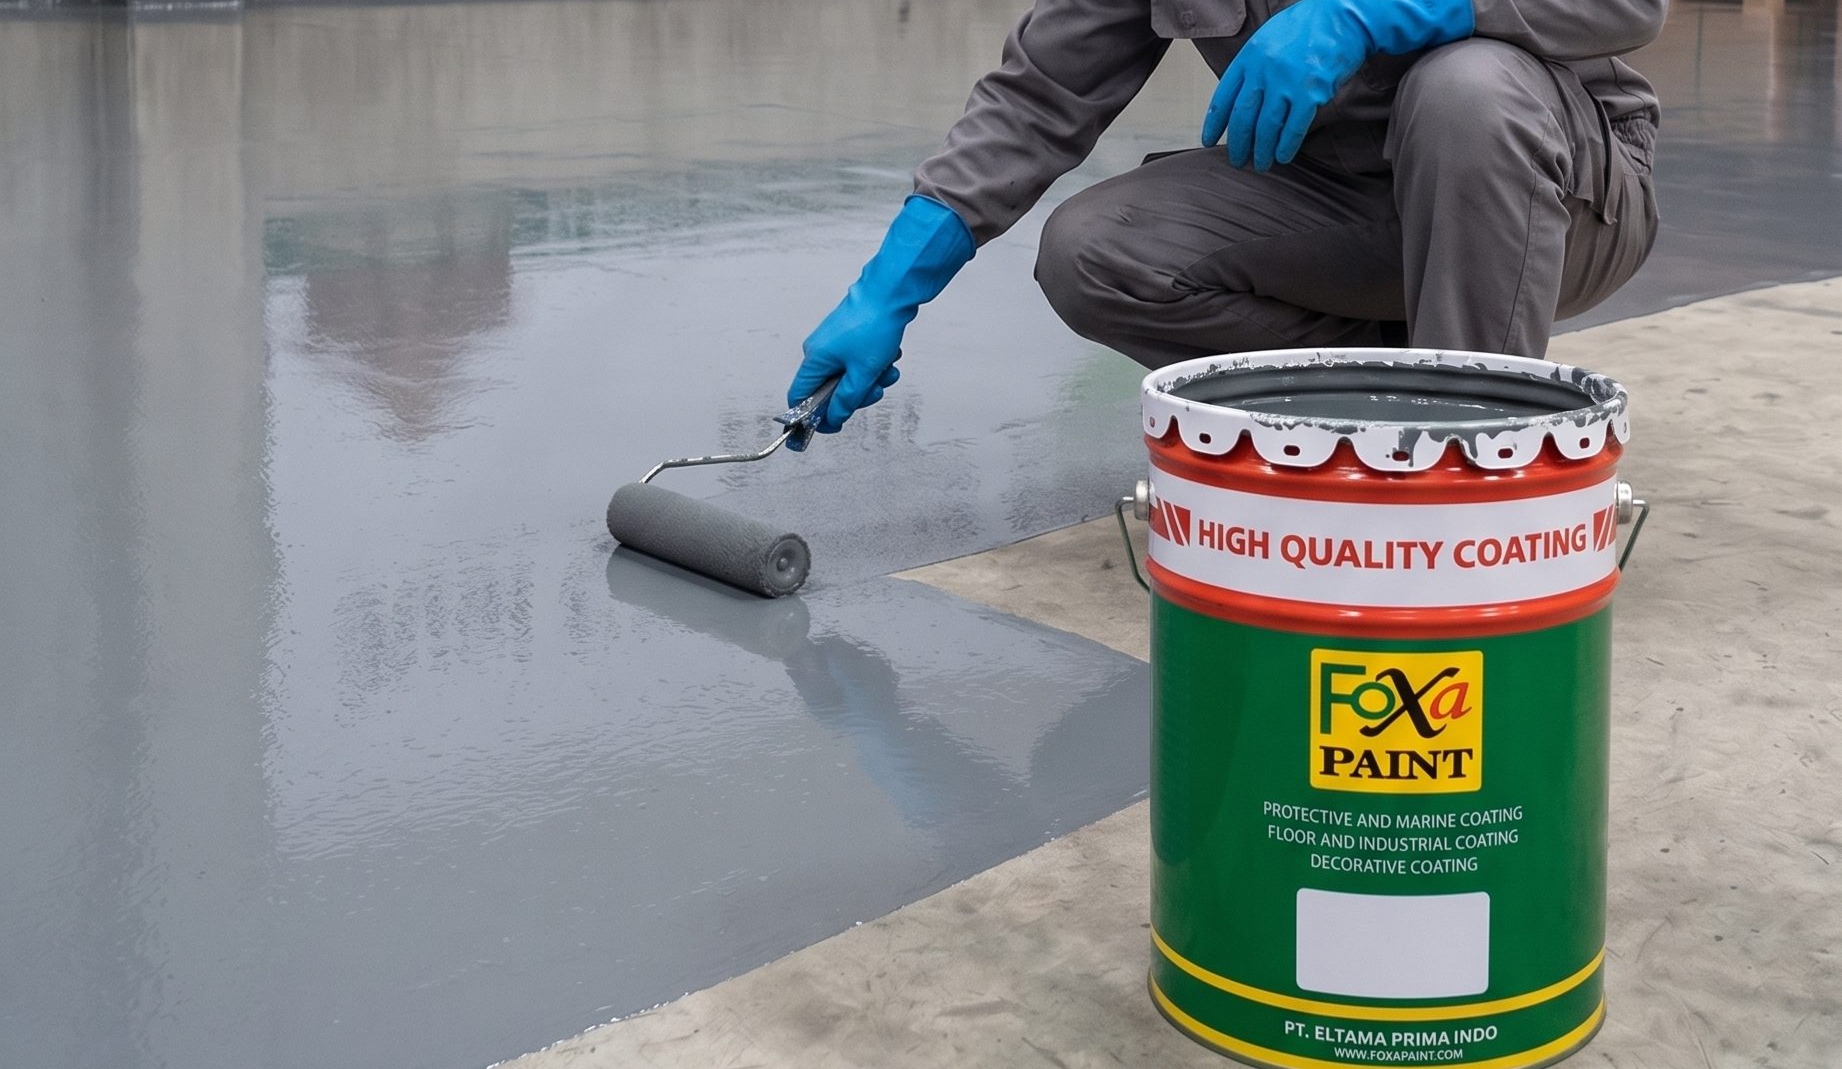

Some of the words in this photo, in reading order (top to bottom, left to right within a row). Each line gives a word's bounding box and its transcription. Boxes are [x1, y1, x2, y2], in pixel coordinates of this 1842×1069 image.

[1199, 518, 1269, 559] HIGH
[1280, 534, 1444, 570] QUALITY
[1453, 523, 1587, 568] COATING
[1319, 745, 1473, 780] PAINT
[1263, 801, 1352, 827] PROTECTIVE
[1357, 814, 1391, 828] AND
[1396, 813, 1456, 829] MARINE
[1460, 805, 1523, 827] COATING
[1268, 825, 1316, 846] FLOOR
[1320, 833, 1355, 849] AND
[1359, 836, 1451, 852] INDUSTRIAL
[1455, 829, 1519, 850] COATING
[1310, 853, 1406, 874] DECORATIVE
[1410, 857, 1478, 875] COATING
[1285, 1020, 1309, 1038] PT.
[1315, 1026, 1387, 1046] ELTAMA
[1392, 1031, 1450, 1047] PRIMA
[1454, 1025, 1498, 1044] INDO
[1334, 1047, 1463, 1061] WWW.FOXAPAINT.COM
